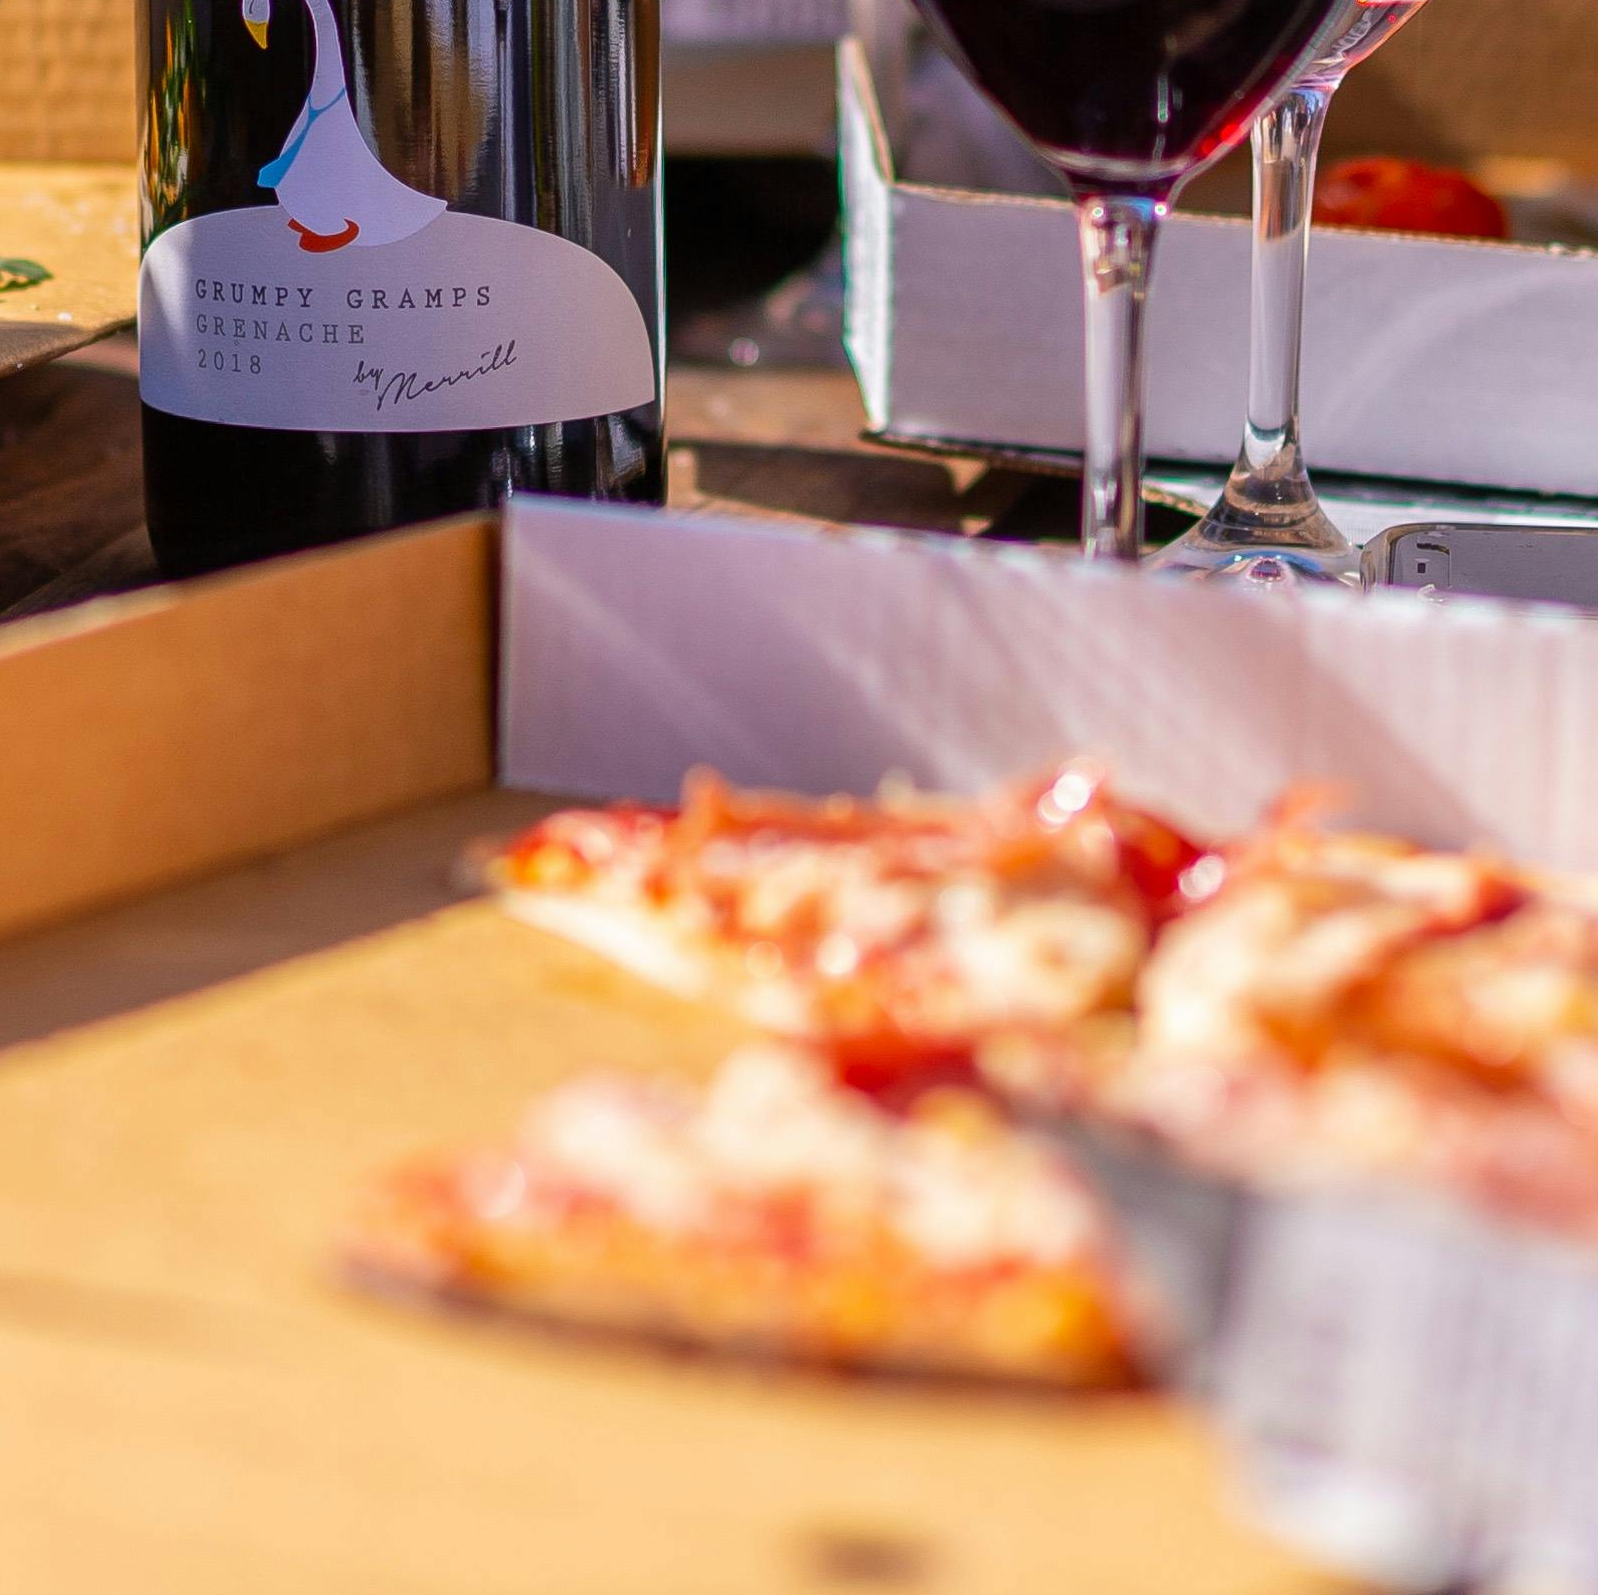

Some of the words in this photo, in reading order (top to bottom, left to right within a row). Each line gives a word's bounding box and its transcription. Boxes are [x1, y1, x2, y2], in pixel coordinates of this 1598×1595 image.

[194, 278, 314, 309] GRUMPY
[346, 285, 492, 310] GRAMPS
[195, 313, 365, 345] GRENACHE
[197, 348, 262, 375] 2018
[353, 360, 385, 391] by
[376, 339, 517, 412] Merrill
